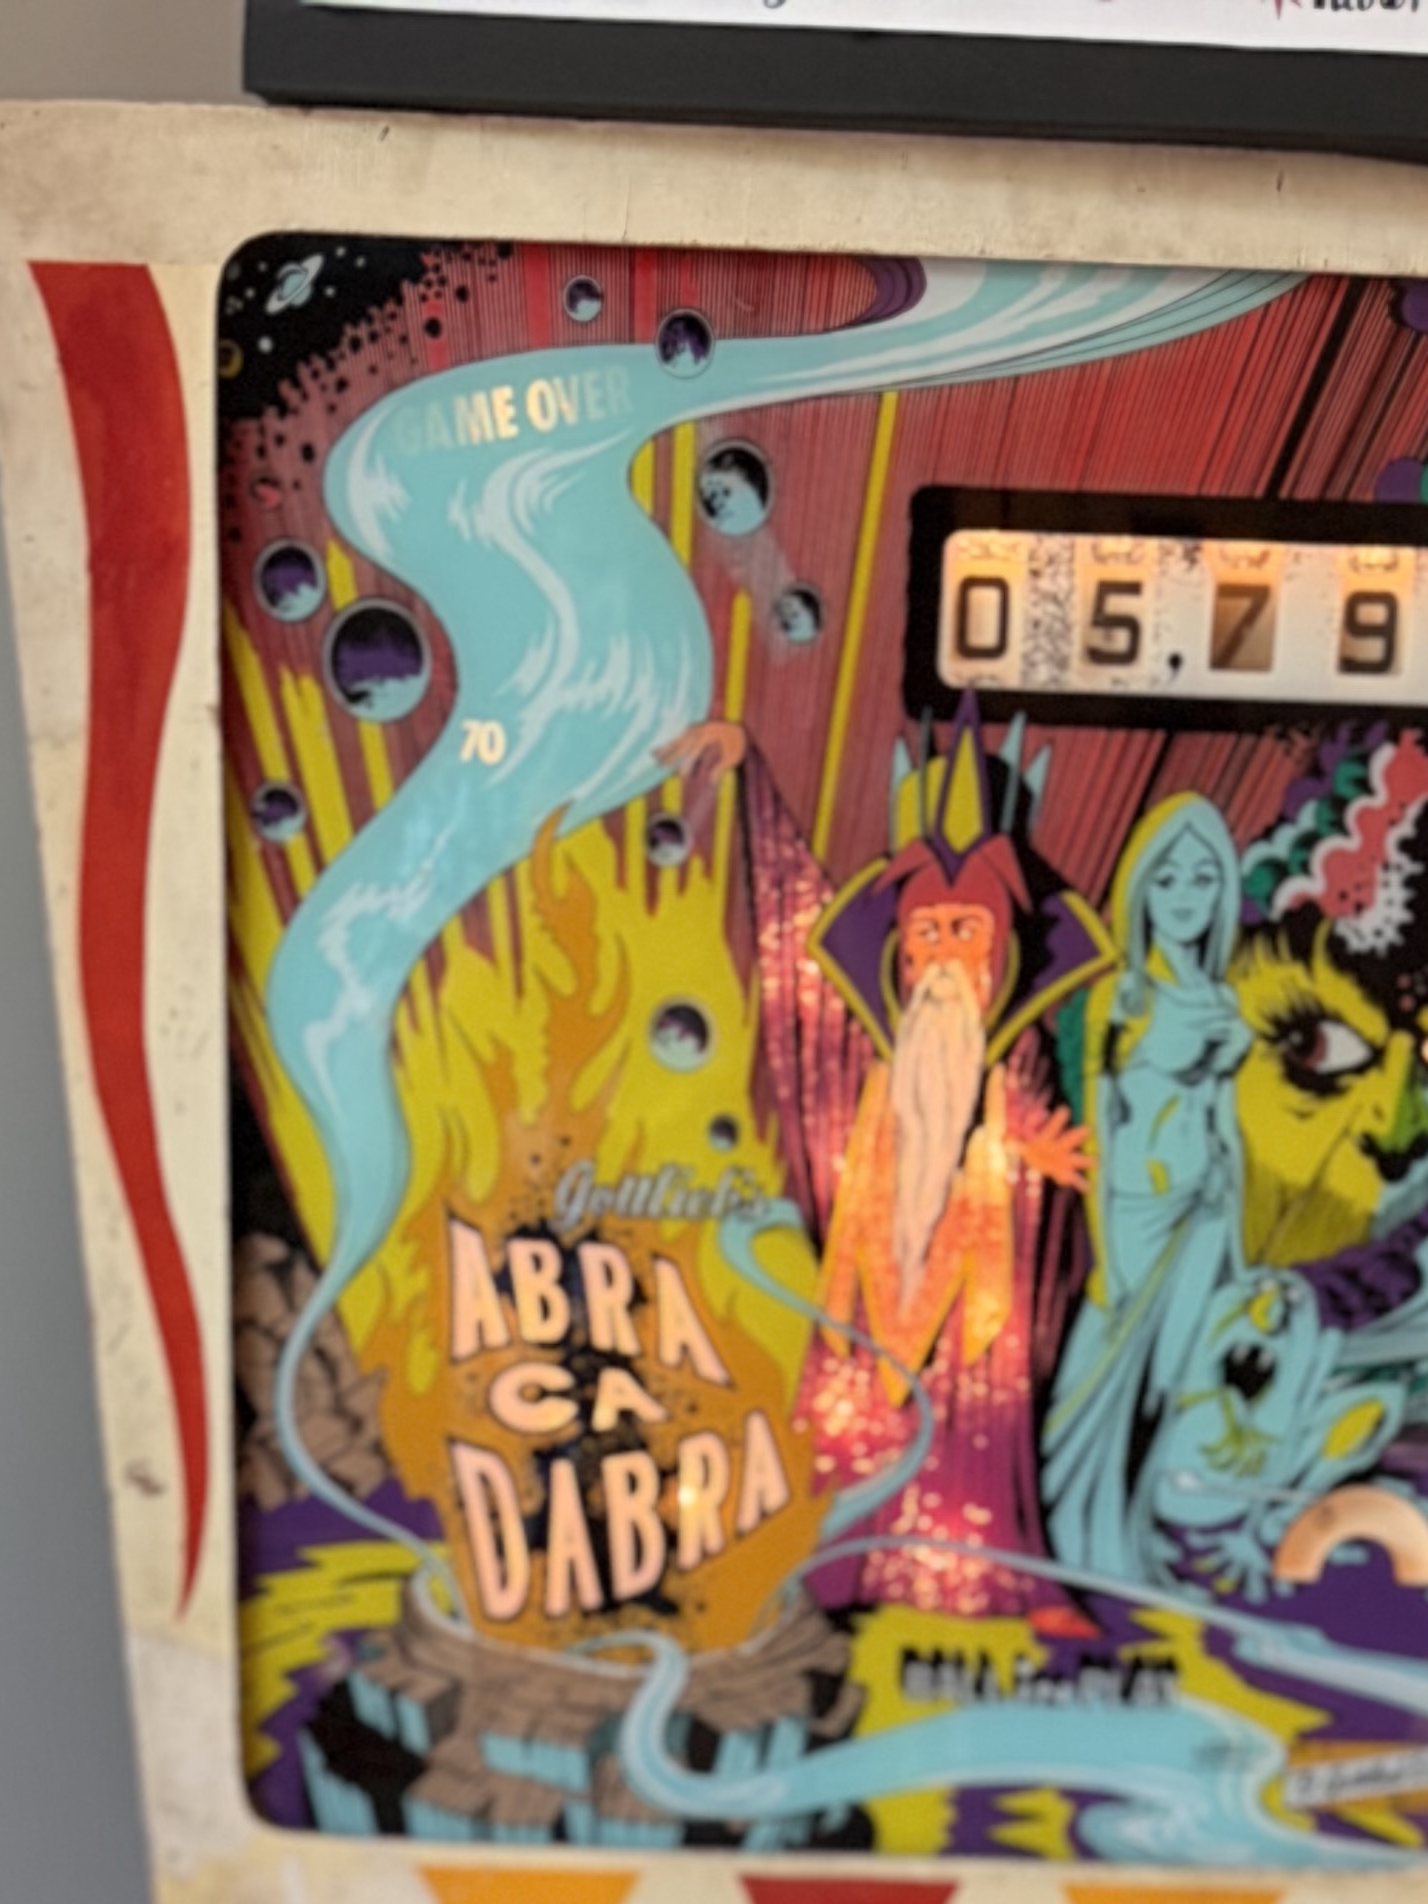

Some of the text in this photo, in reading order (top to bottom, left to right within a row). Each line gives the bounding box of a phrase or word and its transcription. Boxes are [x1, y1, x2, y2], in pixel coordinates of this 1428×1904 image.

[460, 721, 506, 765] 70
[551, 1159, 770, 1233] Gottlieb's
[446, 1210, 736, 1388] ABRA
[487, 1360, 670, 1434] CA
[447, 1408, 792, 1622] DABRA
